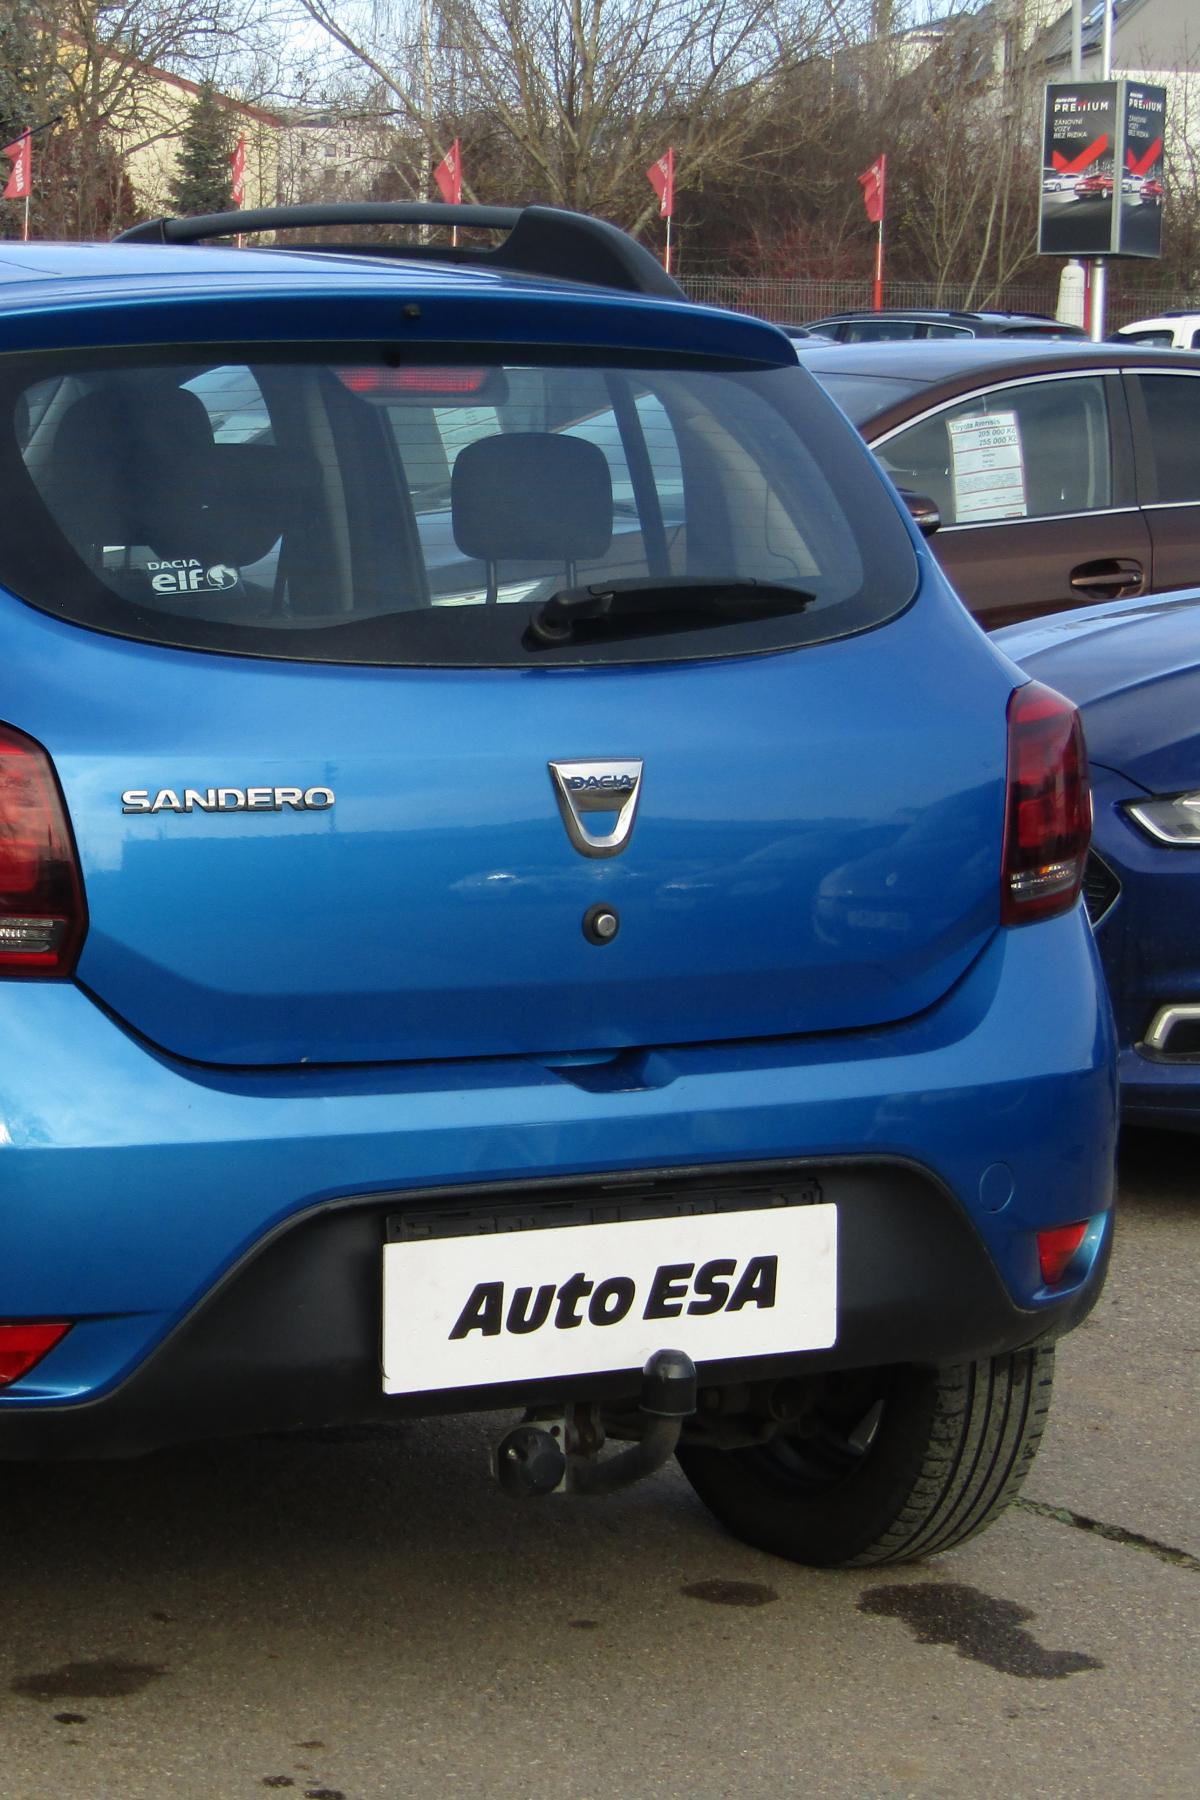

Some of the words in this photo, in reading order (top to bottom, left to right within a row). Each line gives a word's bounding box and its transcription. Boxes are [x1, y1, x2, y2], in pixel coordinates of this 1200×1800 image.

[142, 559, 201, 571] DACIA
[151, 568, 204, 592] elf
[569, 775, 633, 790] DACIA
[122, 787, 336, 814] SANDERO
[448, 1272, 636, 1340] Auto
[642, 1255, 778, 1320] ESA
